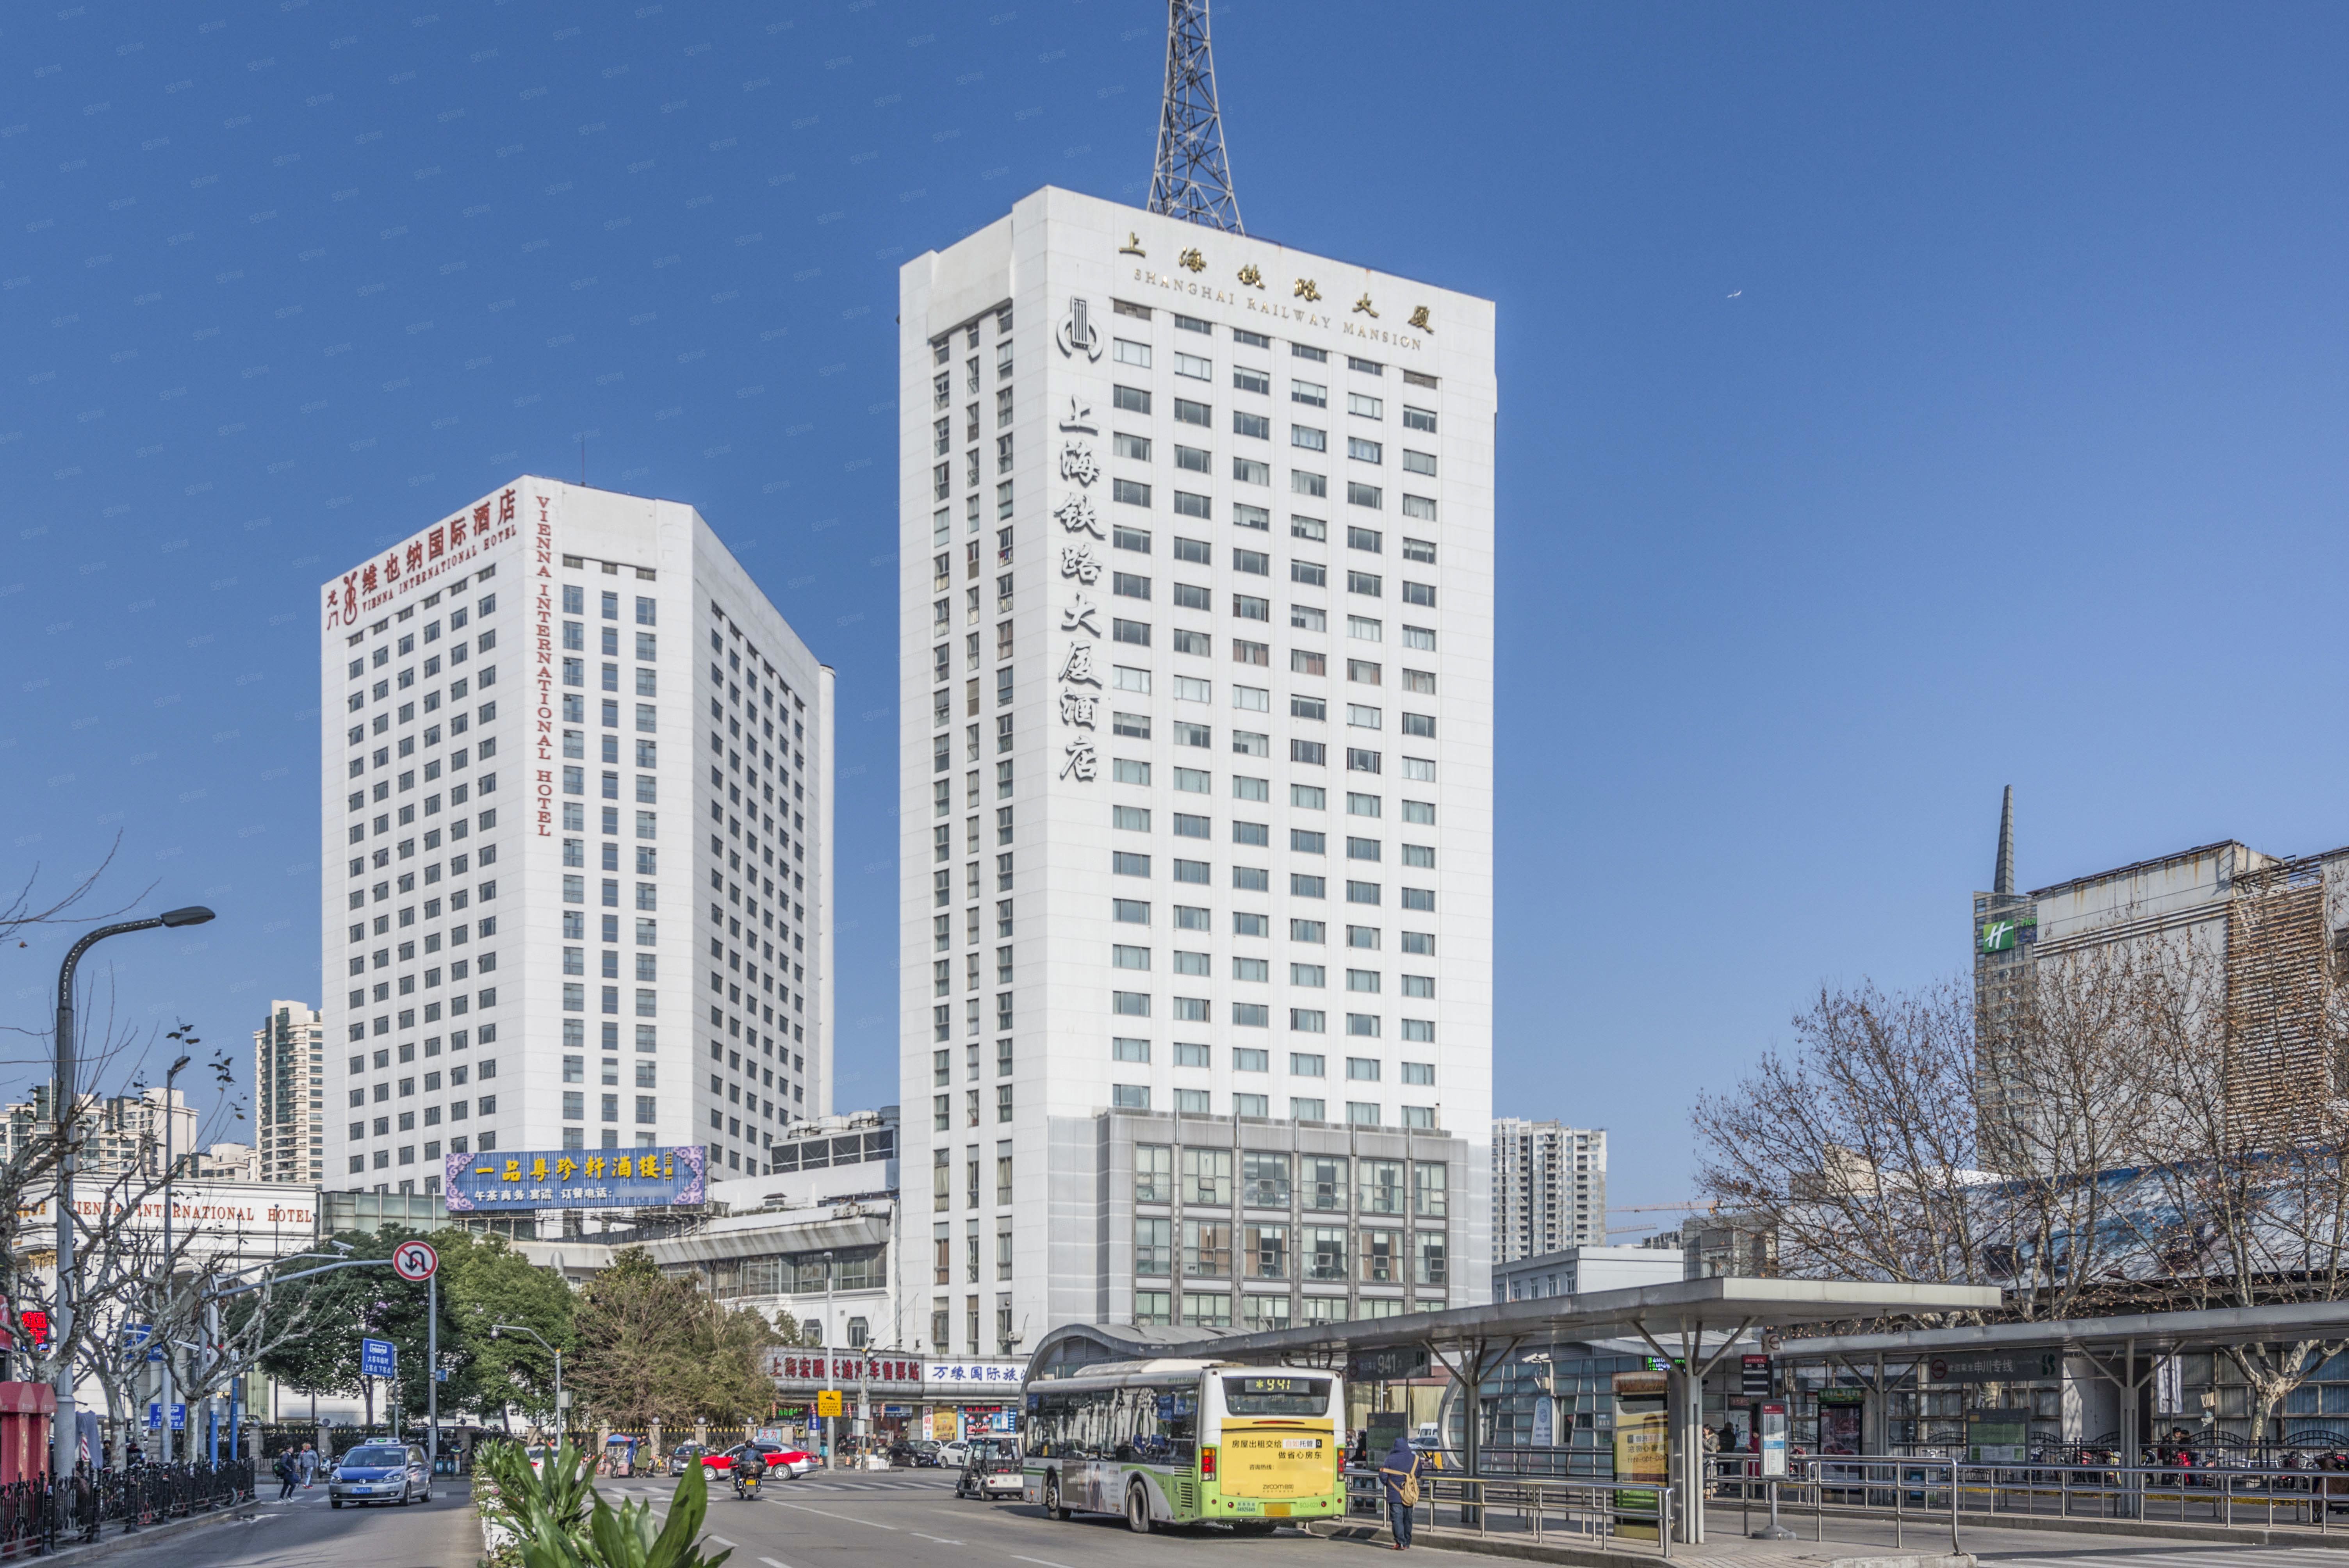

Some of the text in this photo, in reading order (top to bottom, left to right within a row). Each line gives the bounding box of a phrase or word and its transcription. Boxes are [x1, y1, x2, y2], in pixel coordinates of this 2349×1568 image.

[1119, 231, 1434, 335] 上海铁路大厦
[1134, 269, 1421, 351] SHANGHAI RAILWAY MANSION
[361, 489, 516, 596] 维也纳国际酒店
[362, 524, 517, 613] VIENNA INTERNATIONAL HOTEL
[1053, 394, 1106, 782] 上海铁路大厦酒店
[536, 495, 553, 837] VIENNA INTERNATIONAL HOTEL
[137, 1204, 254, 1221] INTRNATIONAL
[268, 1208, 312, 1222] HOTEL
[501, 1189, 525, 1201] 商务
[1378, 1353, 1396, 1374] 941
[1232, 1440, 1281, 1448] 房屋出租交给
[1278, 1451, 1322, 1459] 做省心房东
